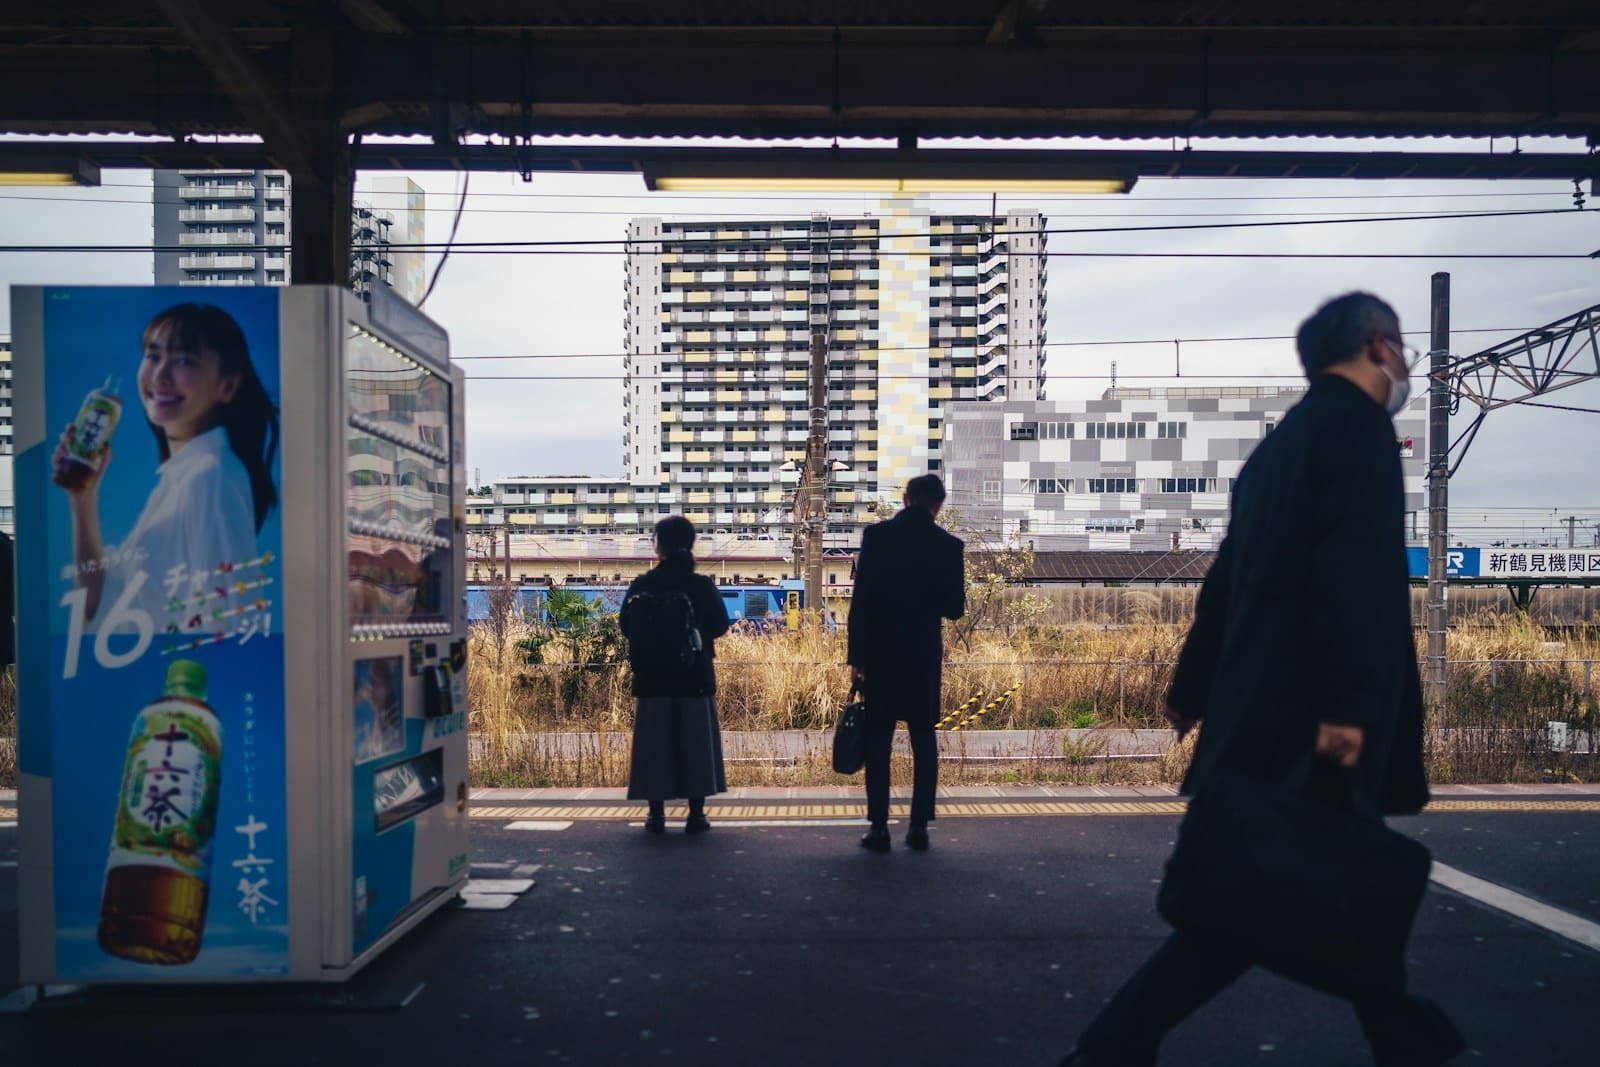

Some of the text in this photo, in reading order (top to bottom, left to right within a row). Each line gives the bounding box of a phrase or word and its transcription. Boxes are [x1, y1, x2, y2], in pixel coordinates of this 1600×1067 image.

[1489, 553, 1600, 573] 新鶴見機関区
[143, 723, 190, 833] 十六茶
[231, 815, 278, 923] 十六茶
